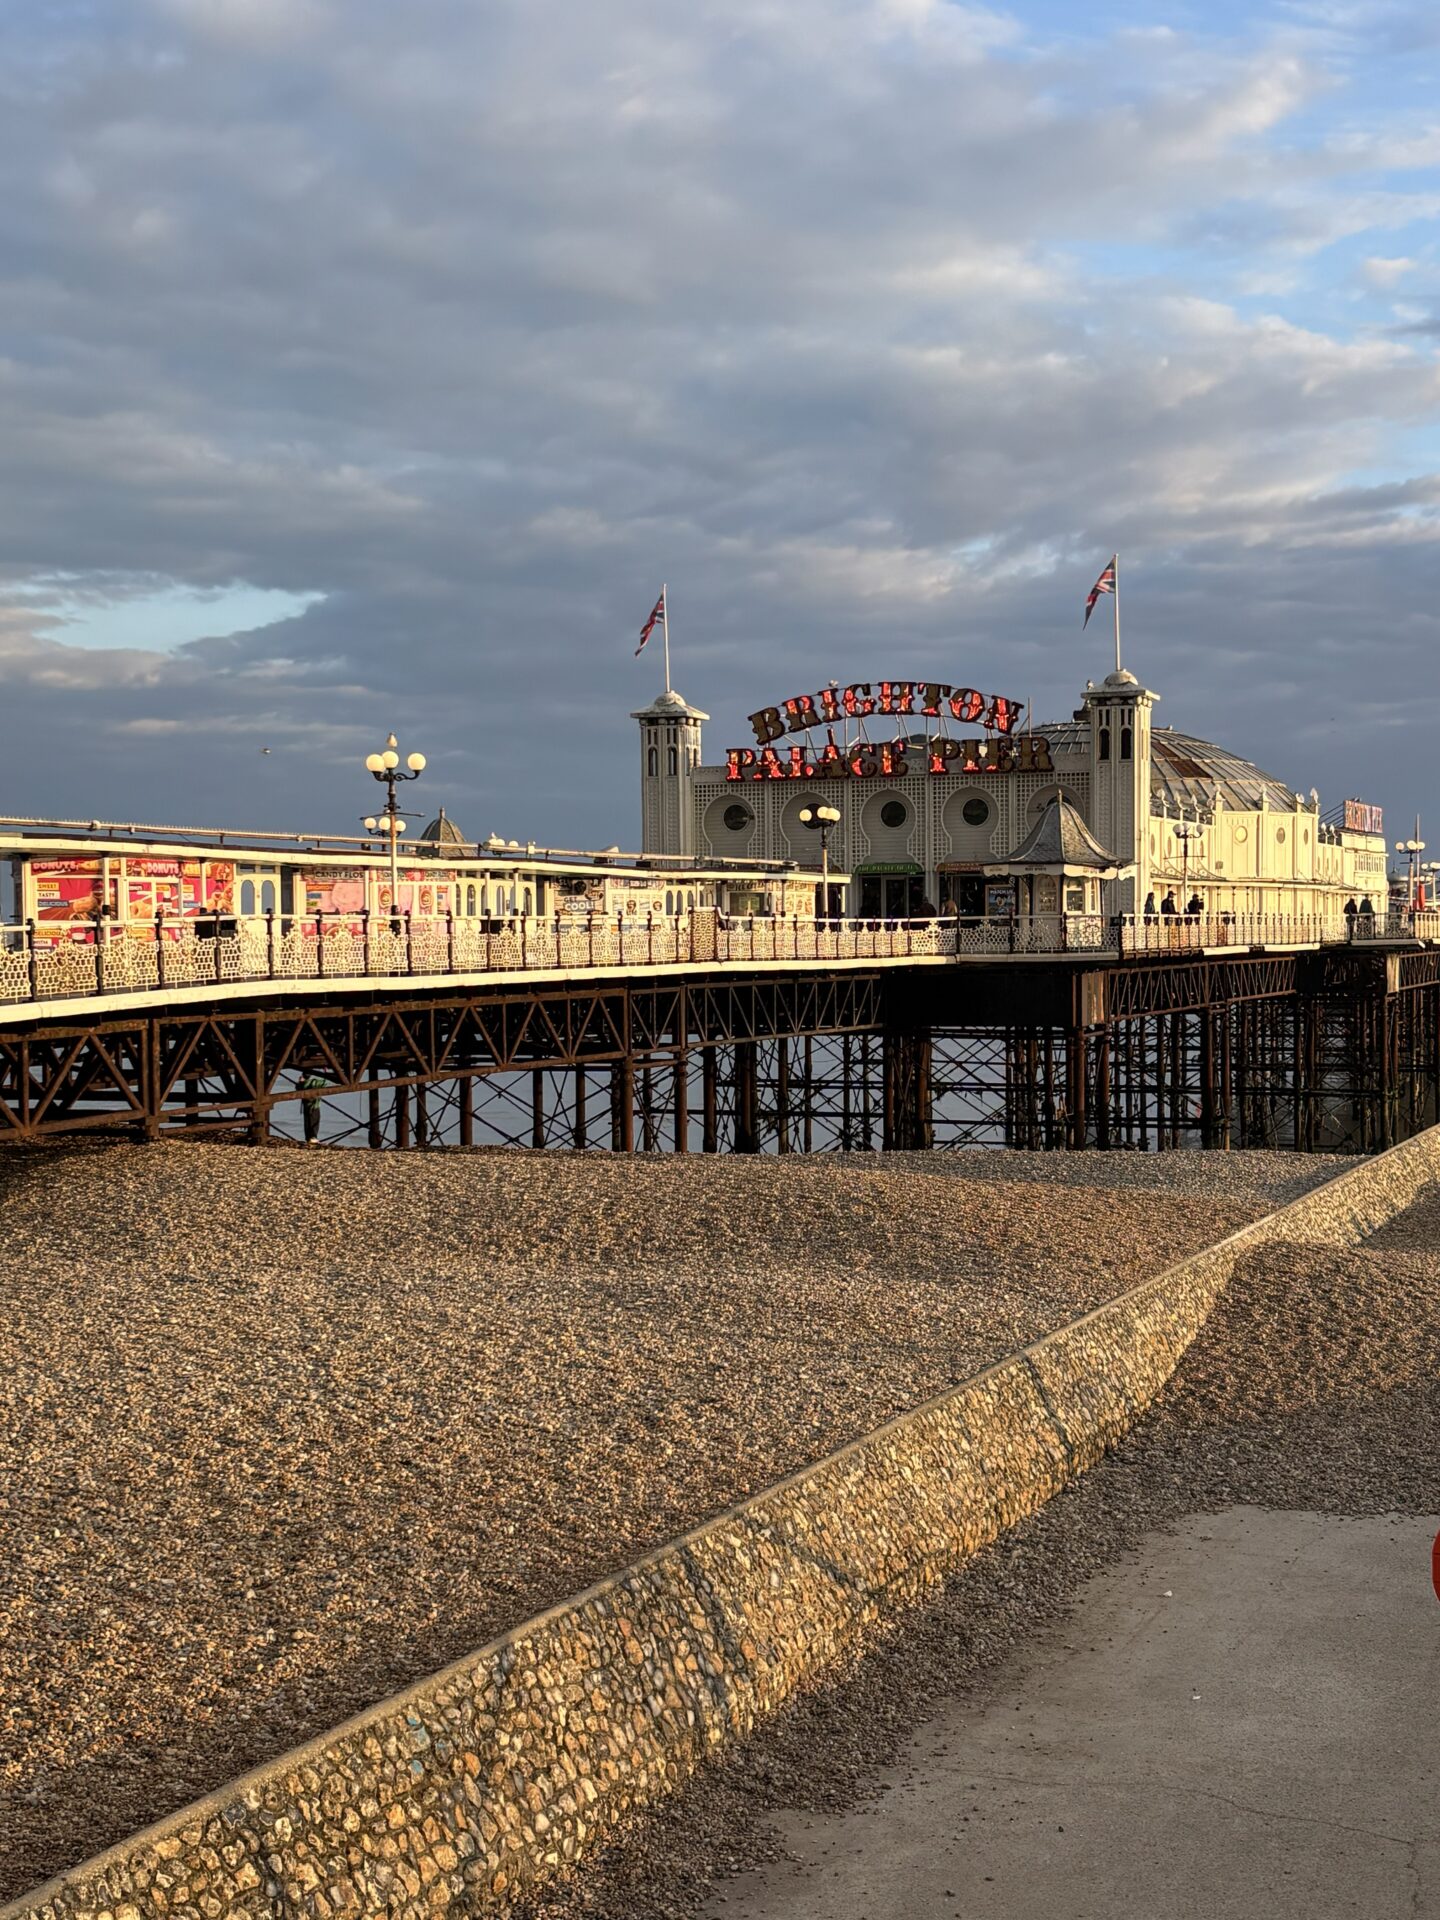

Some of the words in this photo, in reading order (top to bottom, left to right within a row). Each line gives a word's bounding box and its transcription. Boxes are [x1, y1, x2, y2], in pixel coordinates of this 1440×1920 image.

[747, 681, 1025, 745] BRIGHTON
[725, 739, 909, 782] PALACE
[929, 737, 1055, 774] PIER
[32, 861, 76, 871] DONUTS
[147, 862, 179, 875] DONUTS
[344, 871, 365, 879] FLOS
[564, 901, 594, 911] COOL!
